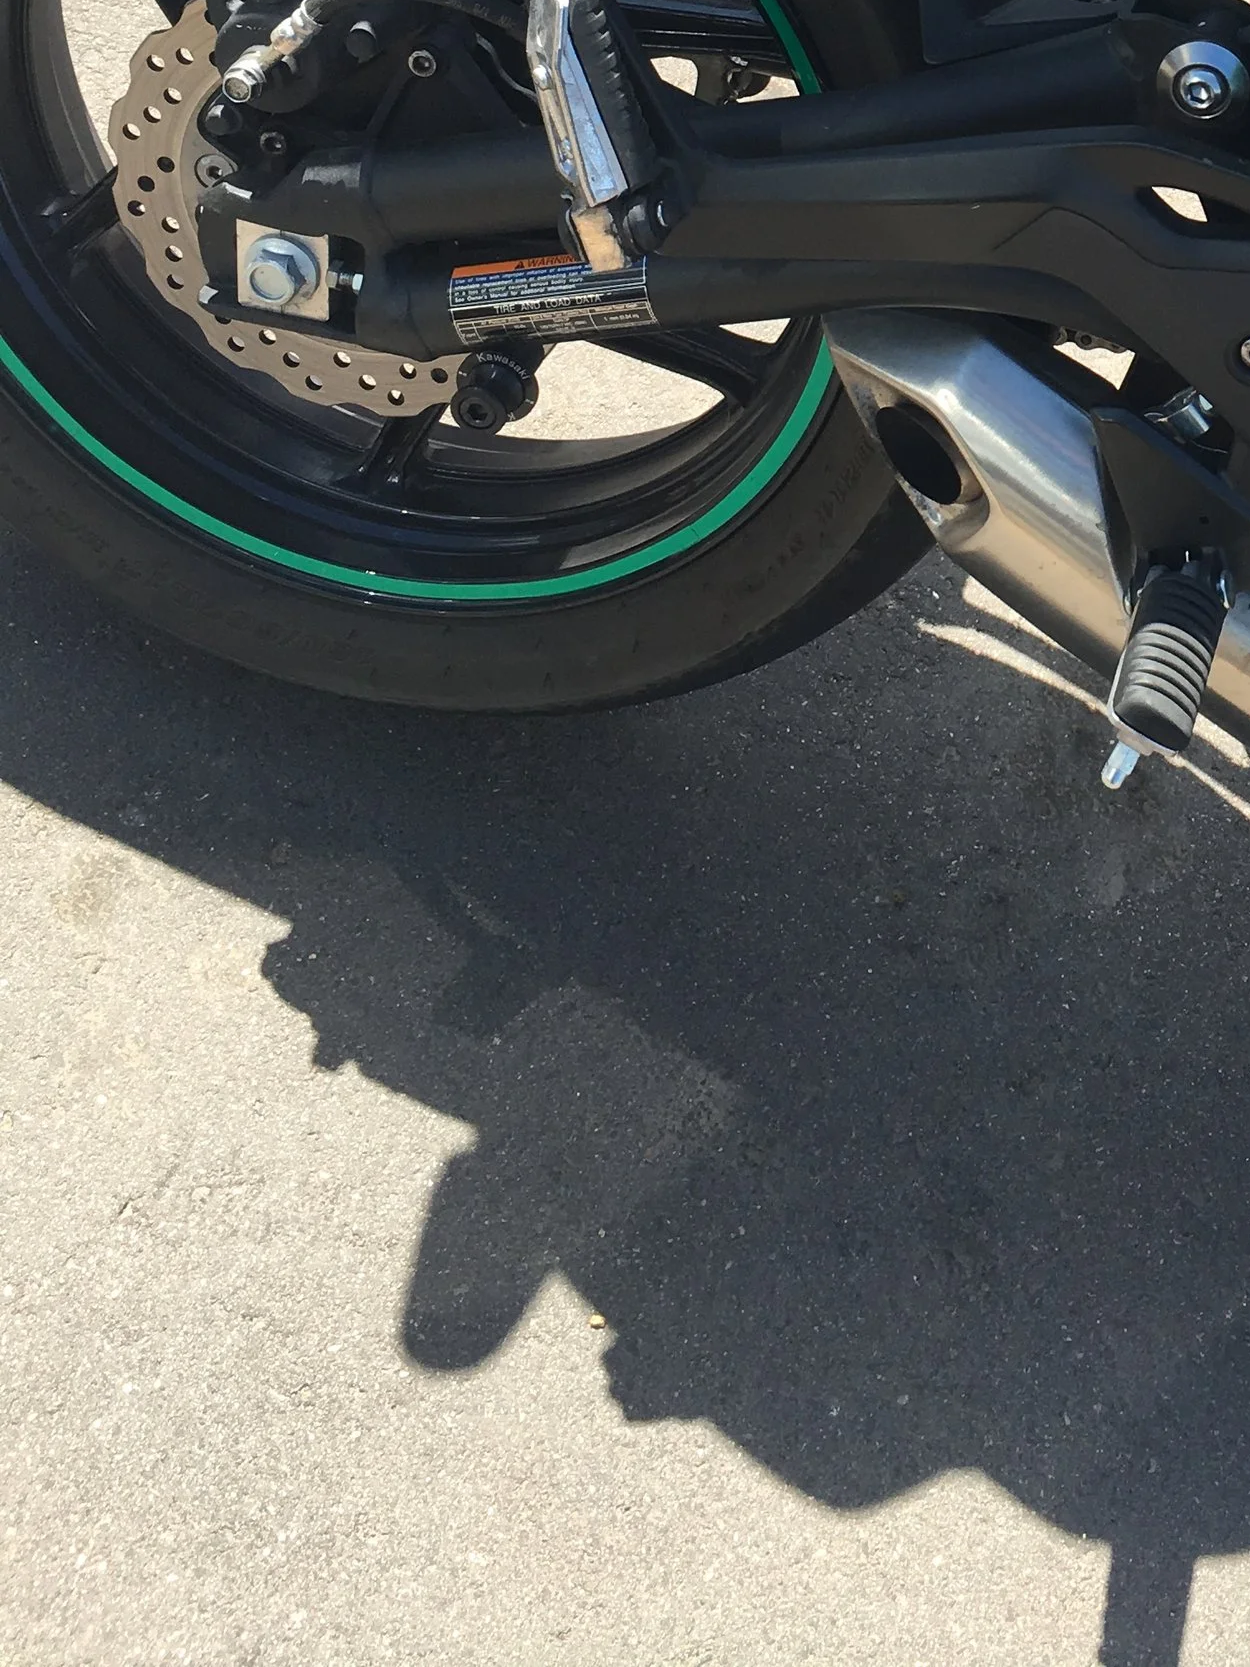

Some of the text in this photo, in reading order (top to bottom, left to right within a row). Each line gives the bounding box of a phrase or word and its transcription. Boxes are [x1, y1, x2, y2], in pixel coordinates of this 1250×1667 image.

[528, 254, 575, 268] WARNIN
[493, 294, 602, 314] TIRE AND LOAD DATA
[475, 351, 532, 381] Kawasaki
